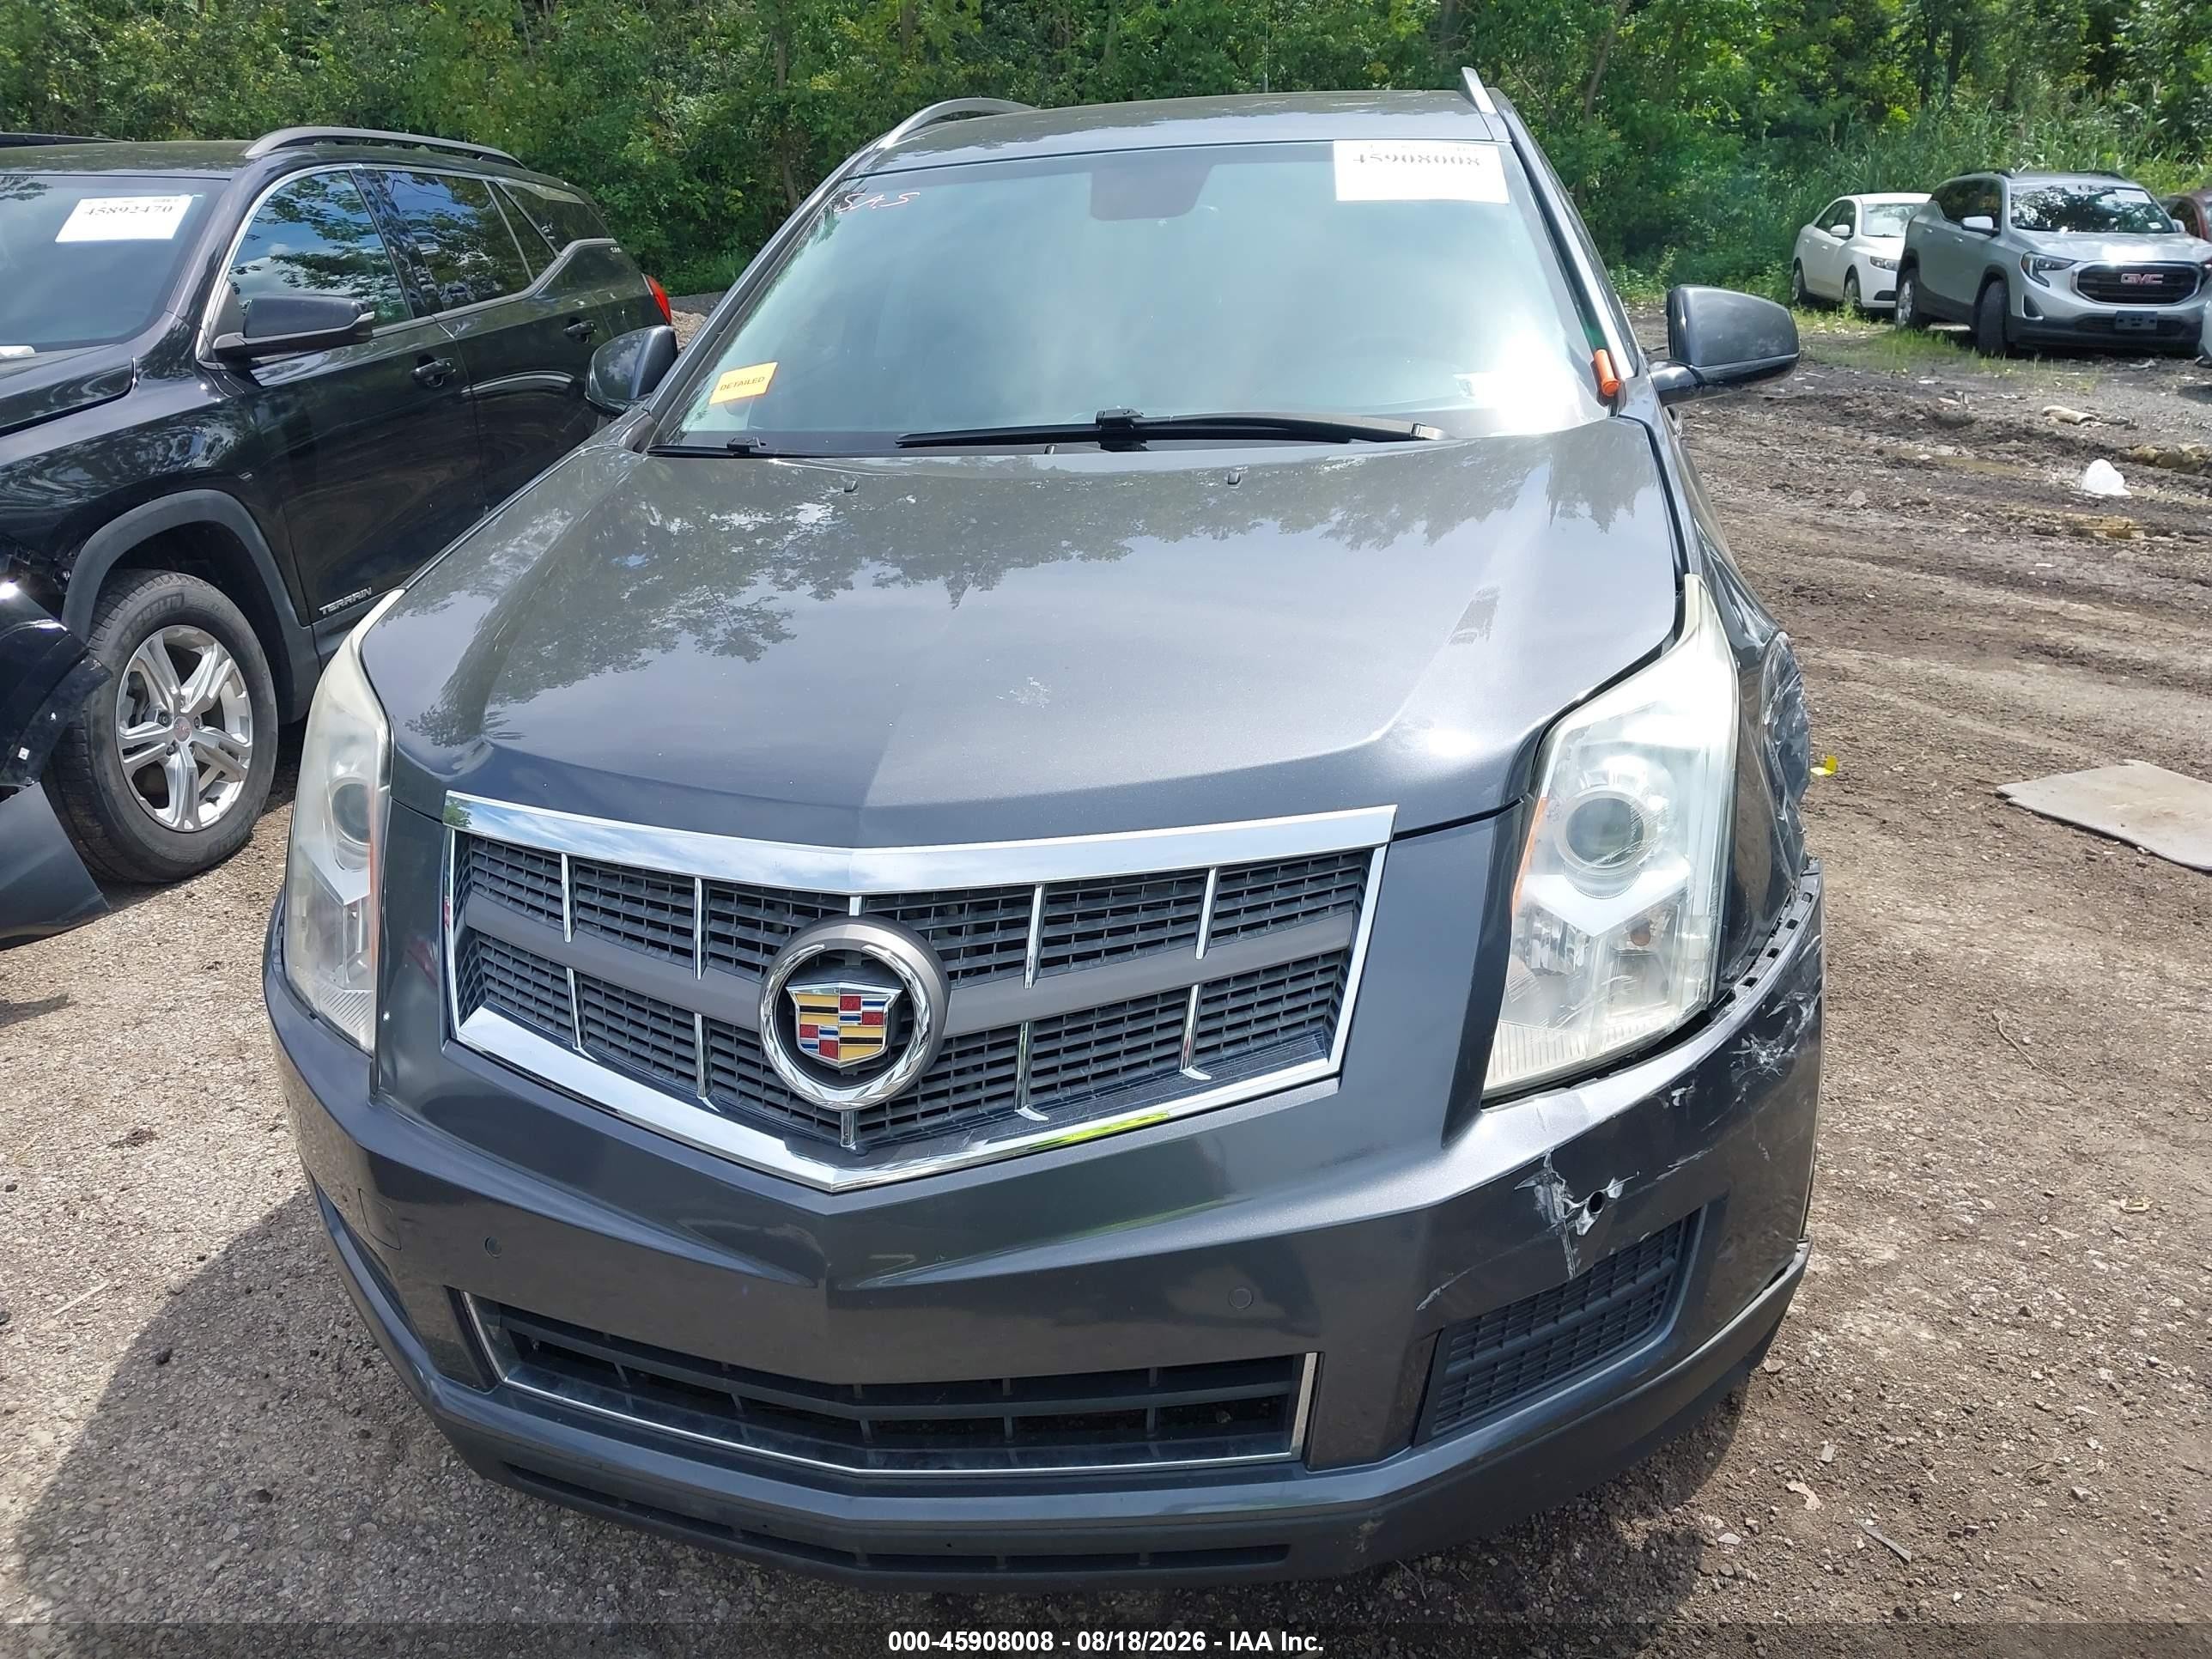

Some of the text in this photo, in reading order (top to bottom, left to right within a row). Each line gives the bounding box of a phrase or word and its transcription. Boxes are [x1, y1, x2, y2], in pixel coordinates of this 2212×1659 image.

[1352, 153, 1480, 167] 45908008
[83, 205, 173, 216] 45892470
[2120, 273, 2164, 284] GMC
[720, 376, 765, 392] DETAILED
[319, 586, 372, 616] TERRAIN
